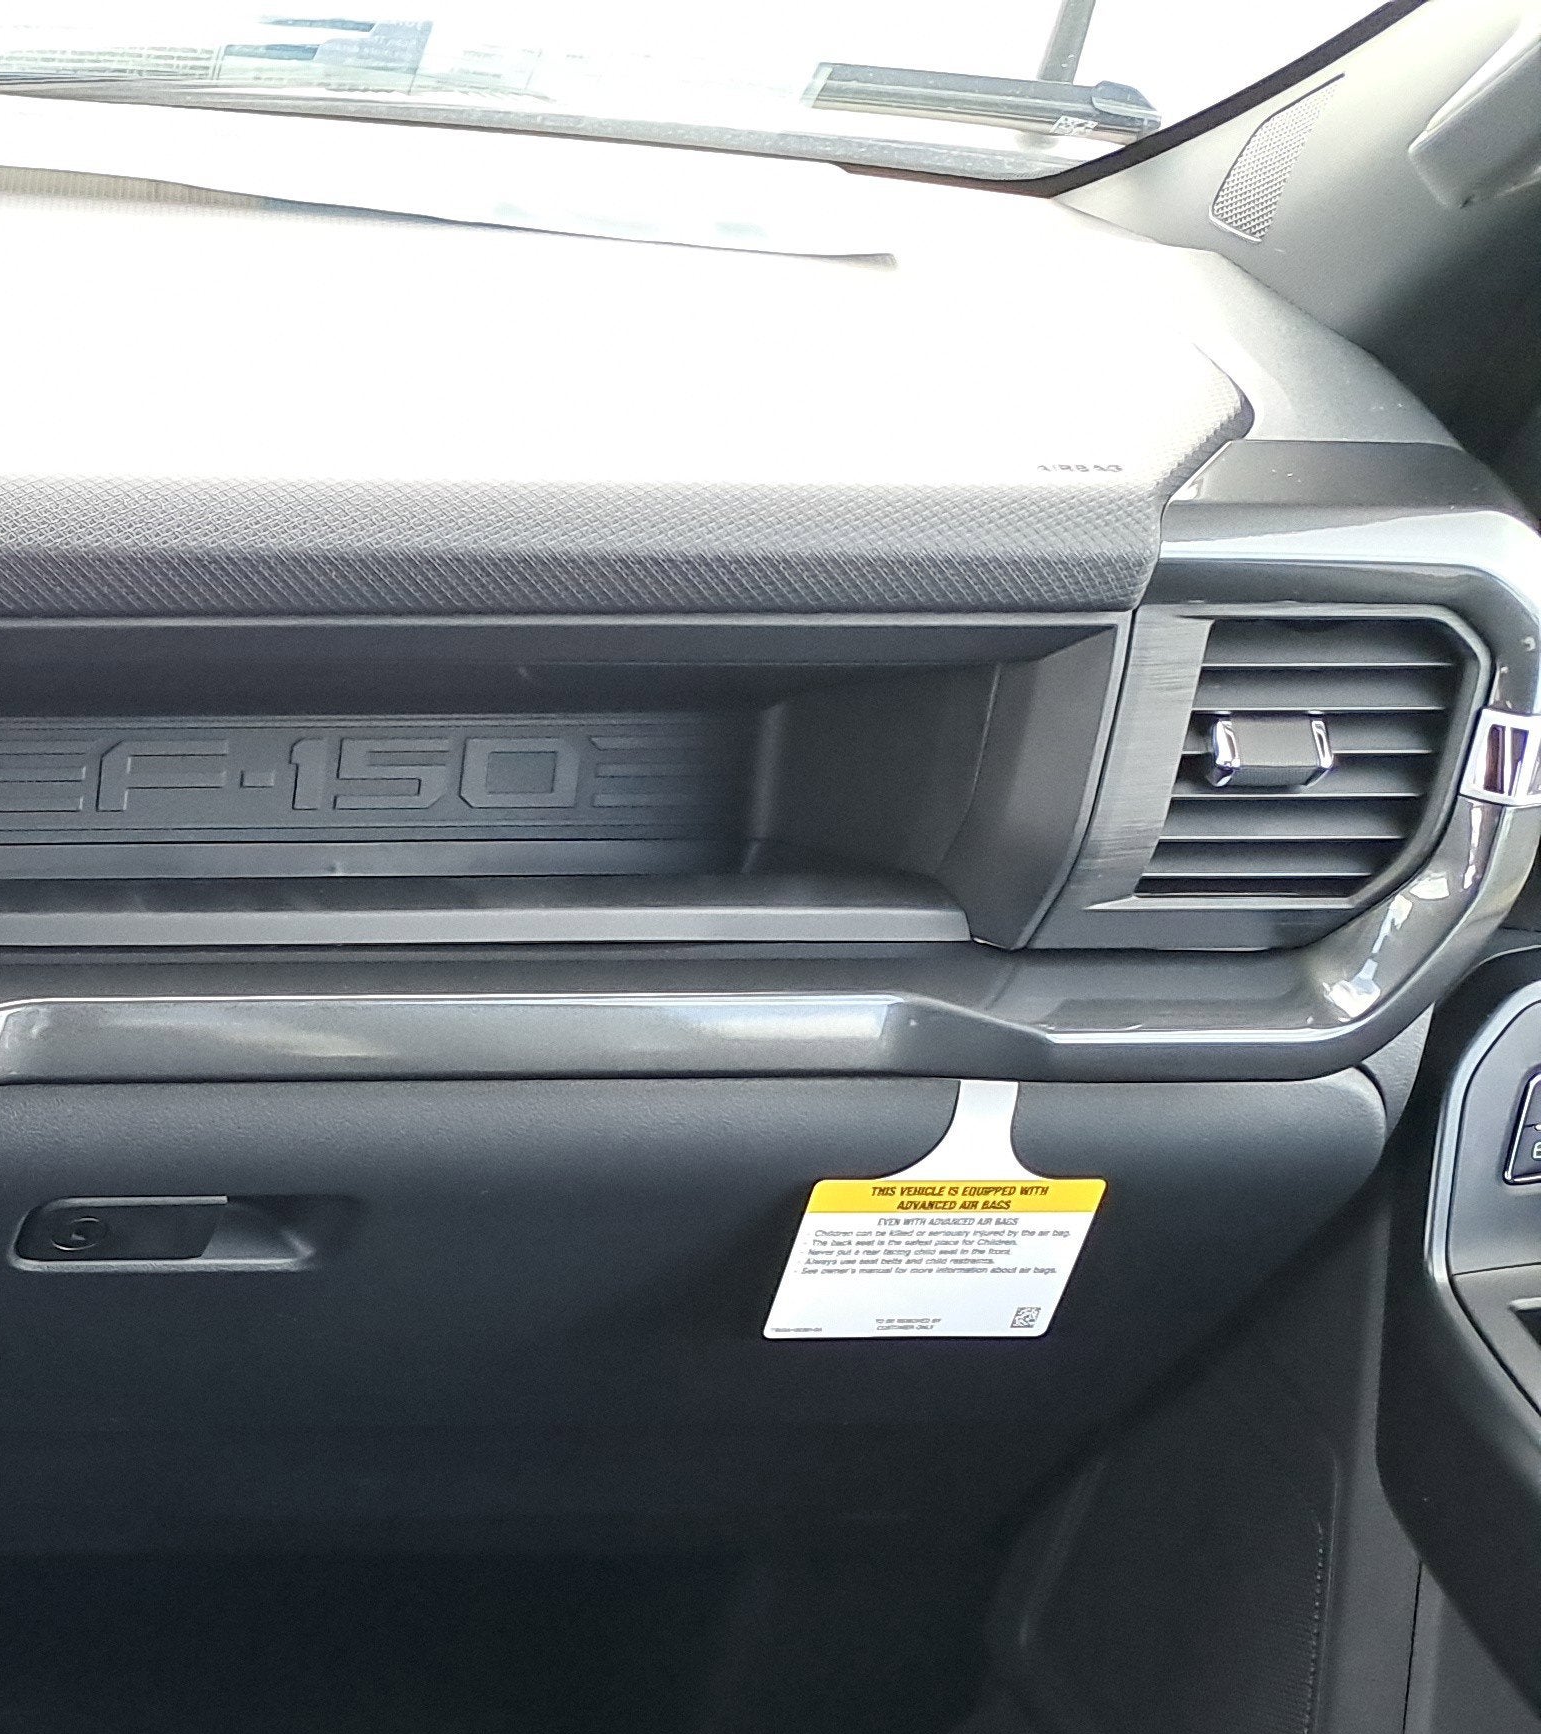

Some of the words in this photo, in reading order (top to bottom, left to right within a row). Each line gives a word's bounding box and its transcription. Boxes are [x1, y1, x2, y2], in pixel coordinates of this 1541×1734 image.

[96, 736, 580, 812] F-150
[871, 1186, 898, 1196] THIS
[900, 1186, 946, 1196] VEHICLE
[948, 1186, 959, 1196] IS
[962, 1186, 1017, 1196] EQUIPPED
[1019, 1186, 1050, 1196] WITH
[897, 1200, 958, 1210] ADVANCED
[959, 1200, 979, 1210] AIR
[981, 1200, 1012, 1210] BAGS
